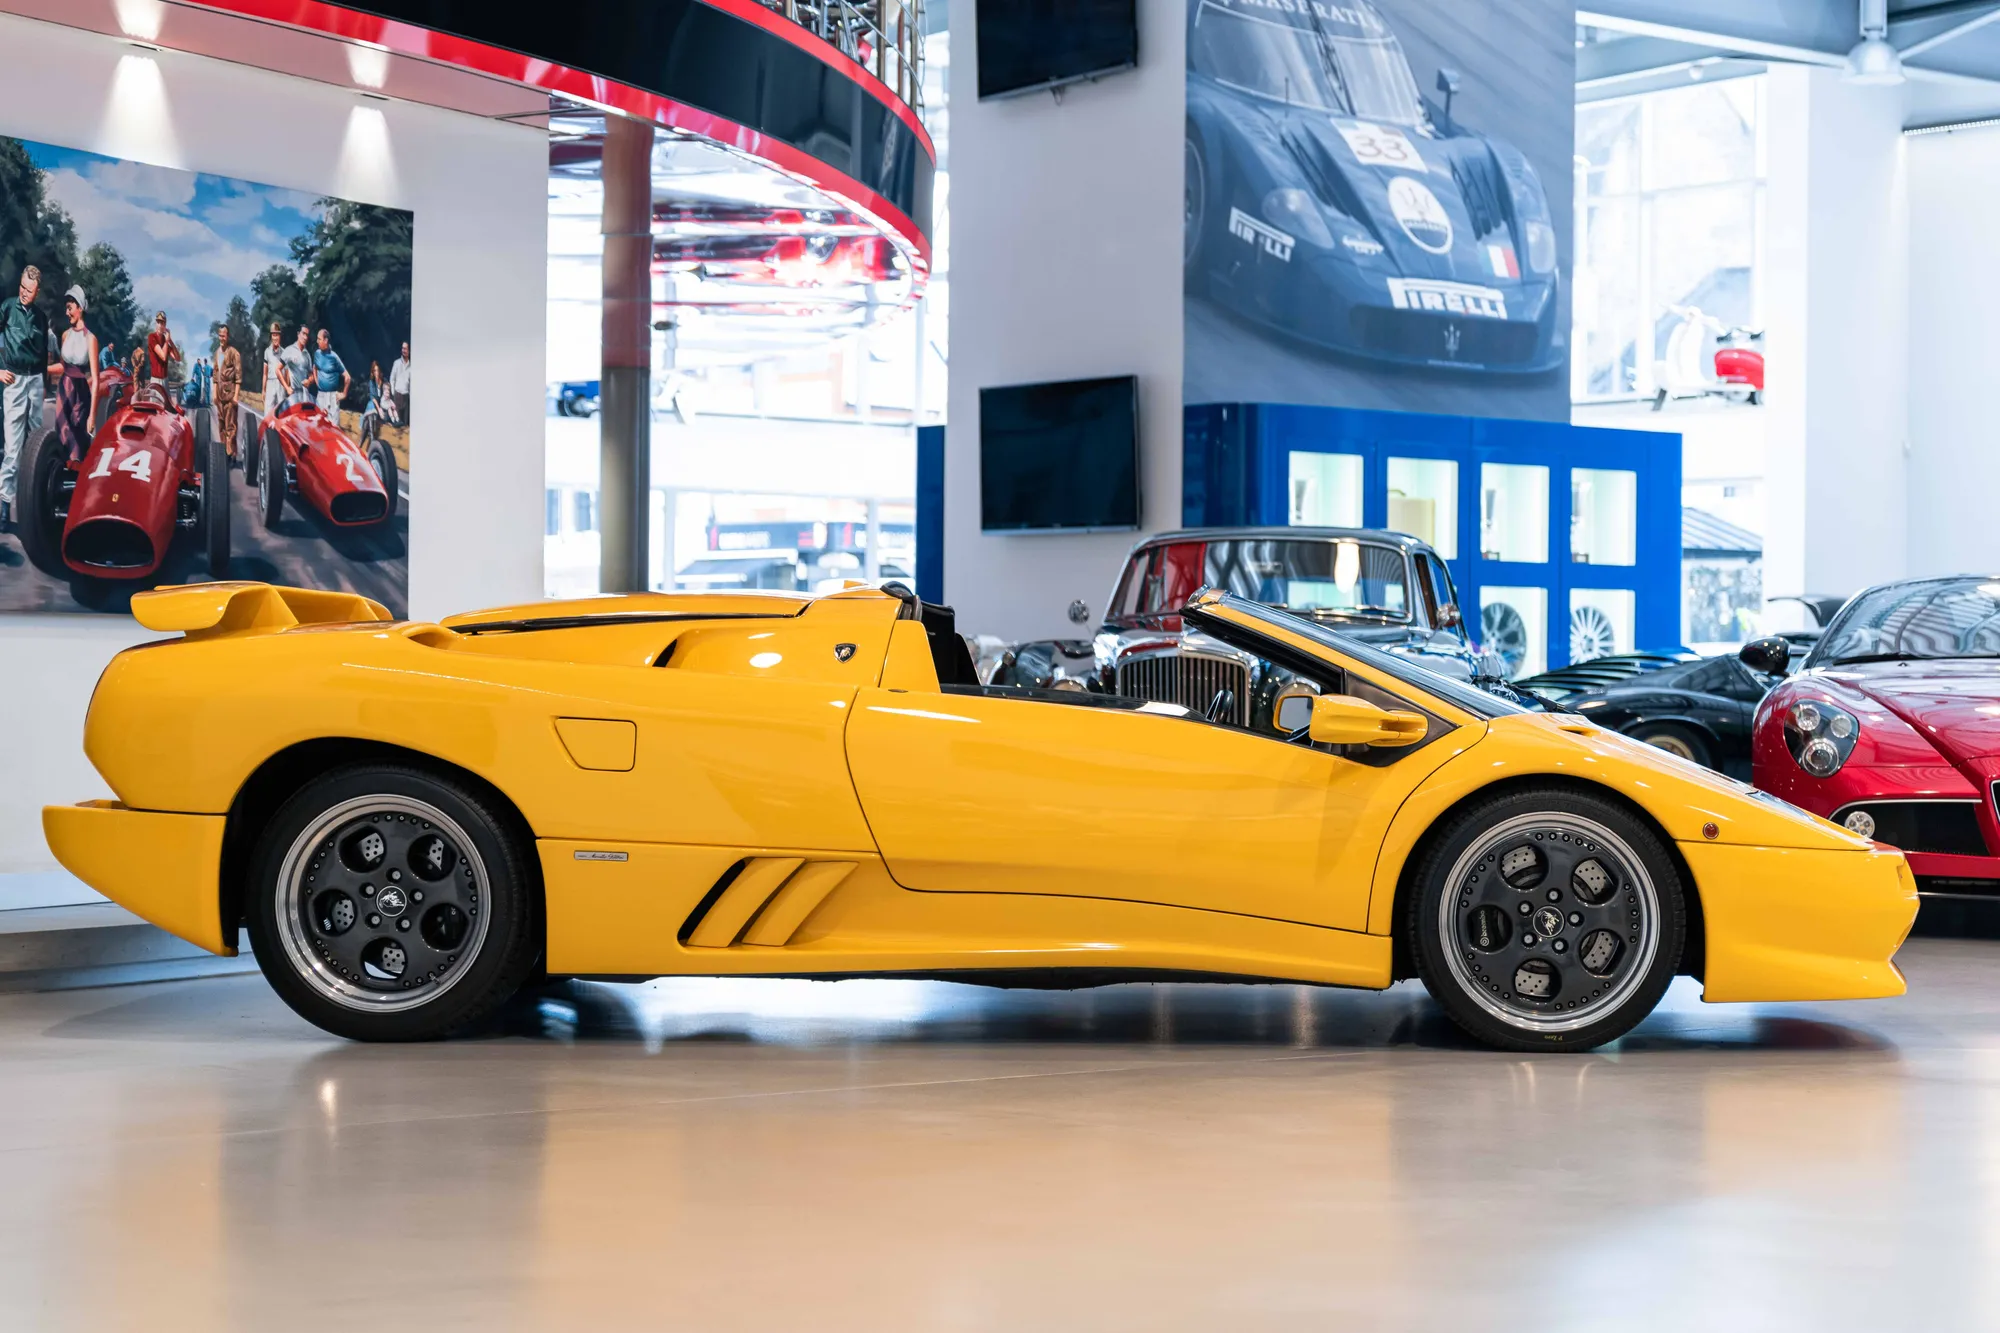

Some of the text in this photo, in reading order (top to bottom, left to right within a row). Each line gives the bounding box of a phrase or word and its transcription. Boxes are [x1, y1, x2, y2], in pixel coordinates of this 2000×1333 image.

[1355, 134, 1408, 161] 33
[1386, 277, 1508, 320] PIRELLI
[88, 447, 152, 483] 14
[336, 452, 364, 482] 2
